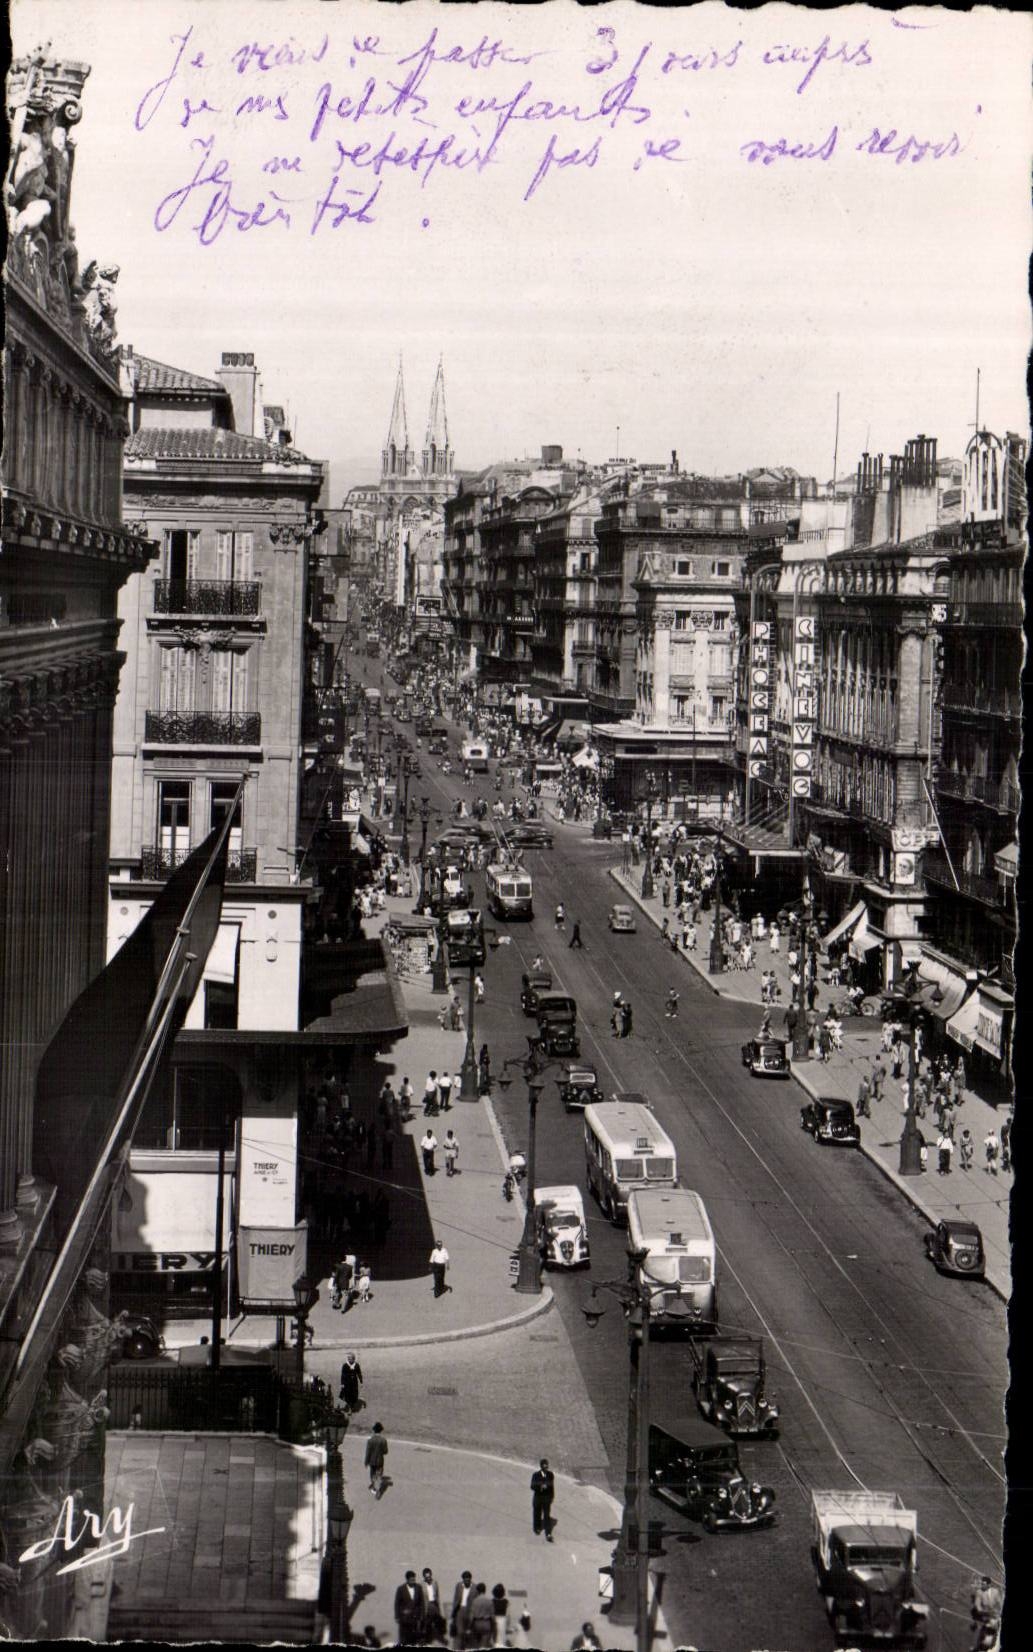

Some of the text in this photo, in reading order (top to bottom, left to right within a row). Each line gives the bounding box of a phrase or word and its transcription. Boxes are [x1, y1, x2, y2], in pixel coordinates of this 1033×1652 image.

[585, 26, 618, 74] 3
[794, 615, 815, 798] CINEVOG
[249, 1242, 296, 1257] THIERY
